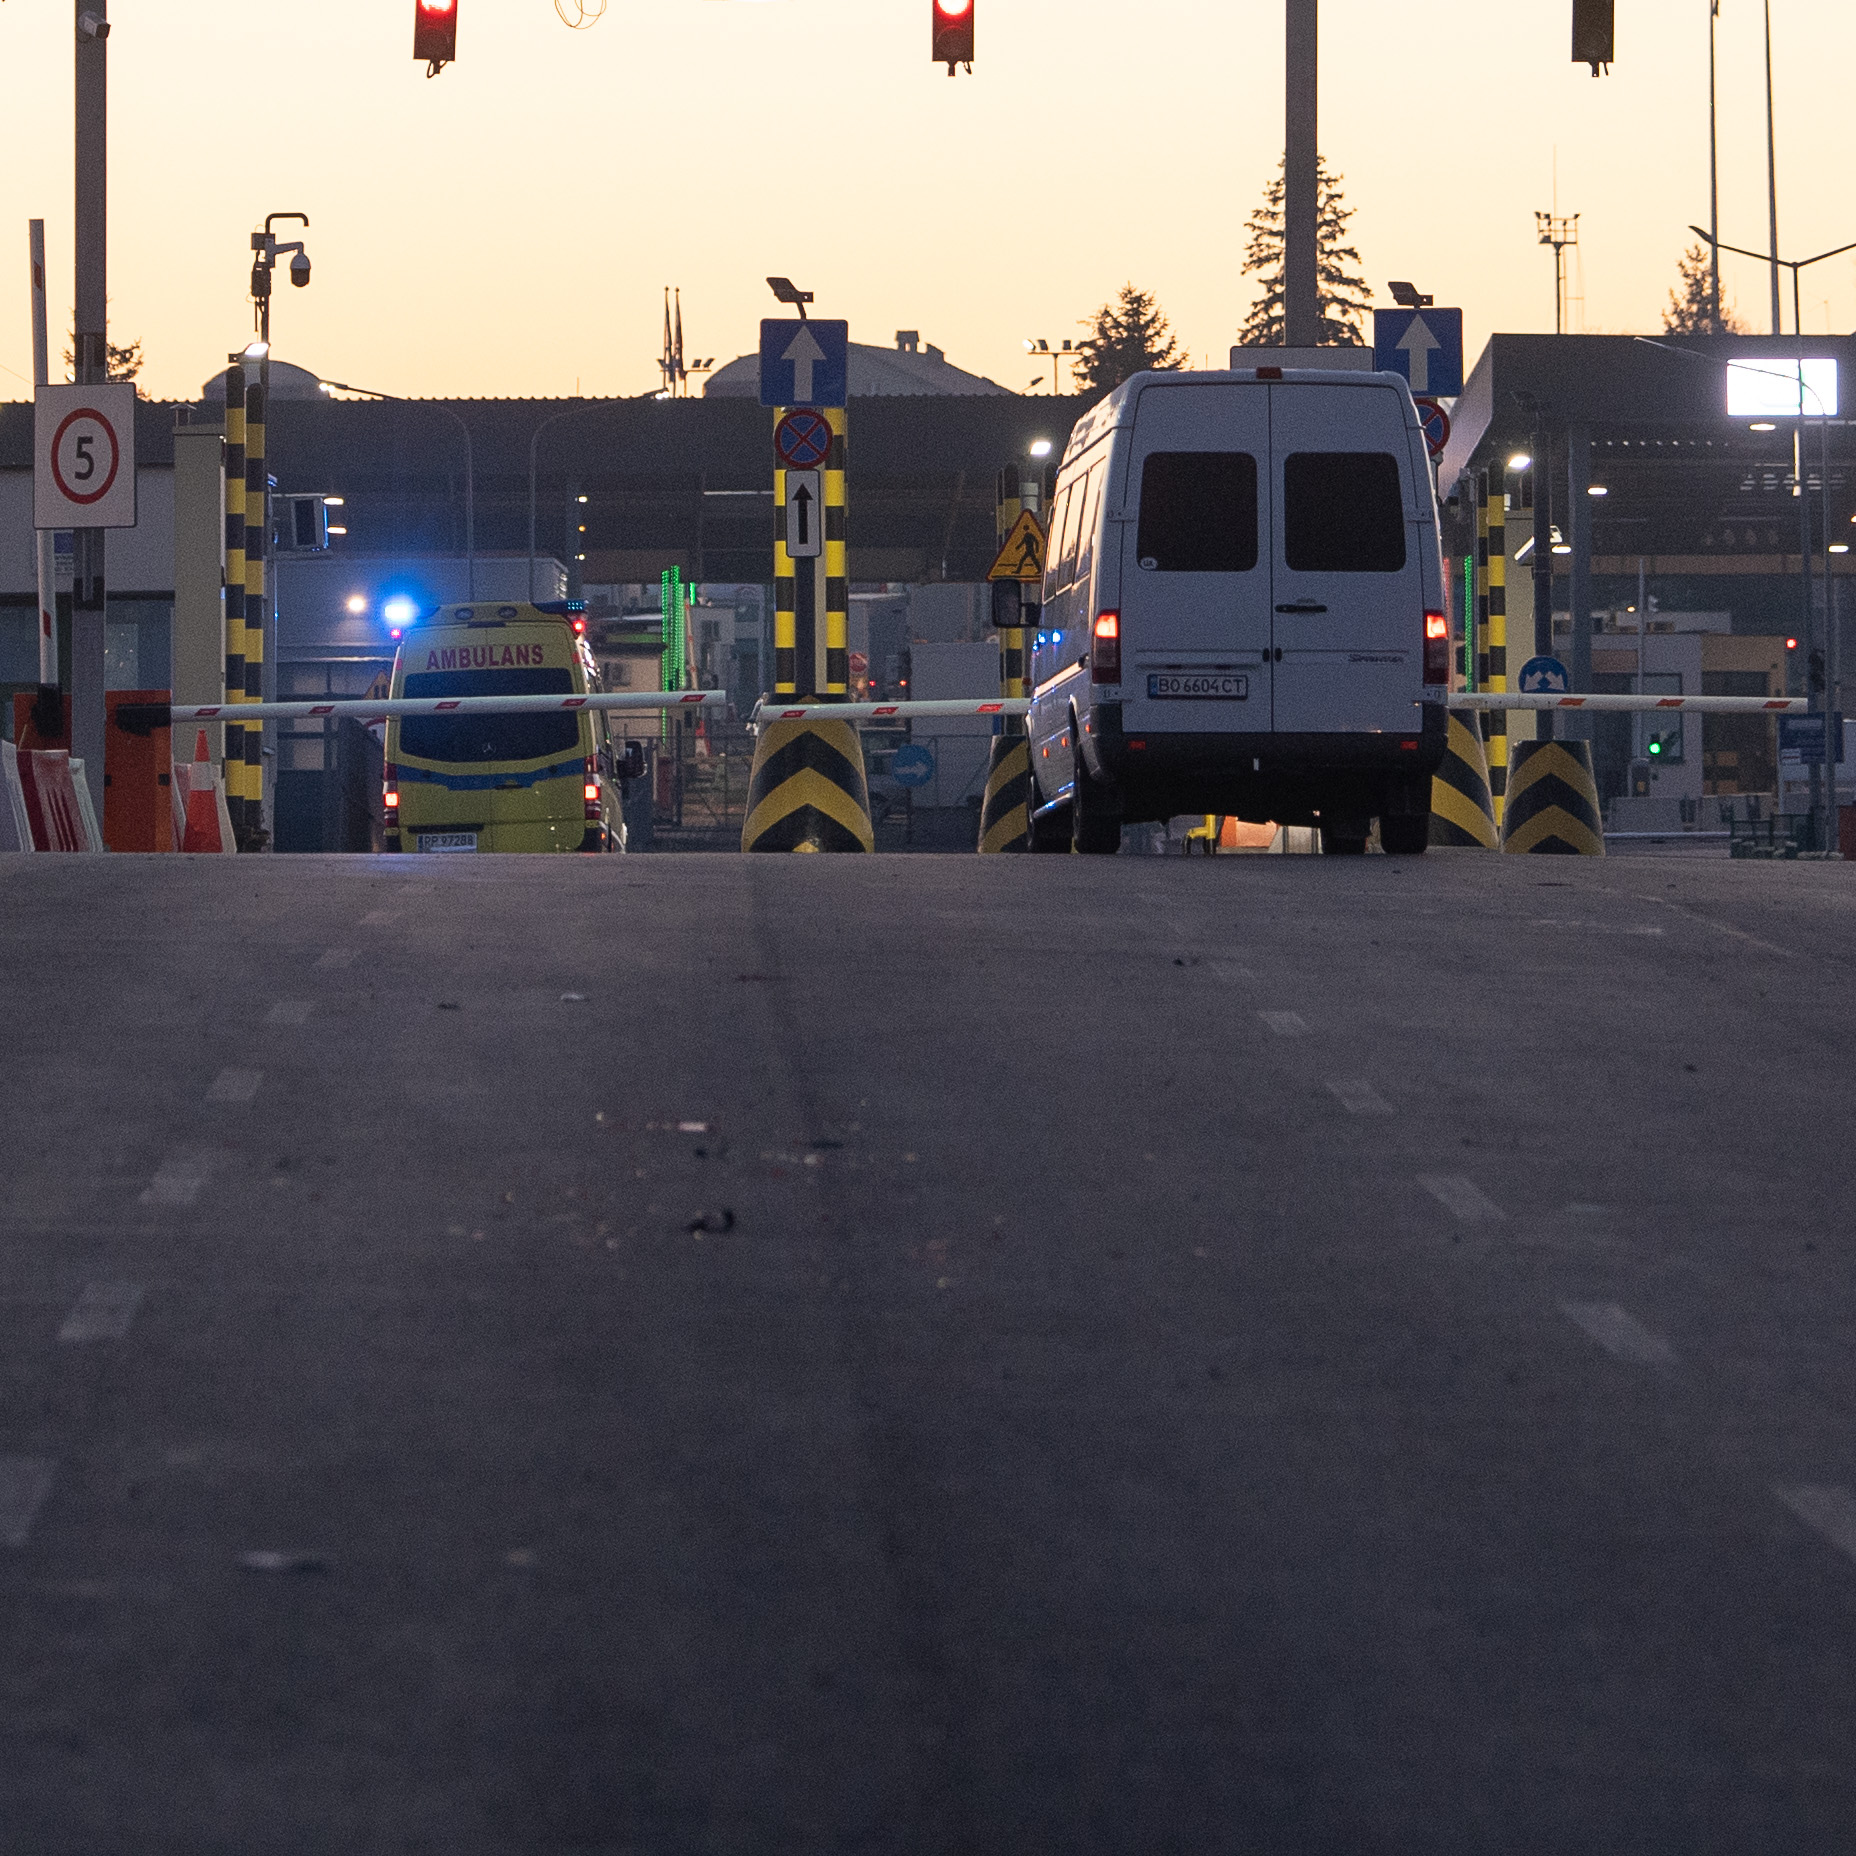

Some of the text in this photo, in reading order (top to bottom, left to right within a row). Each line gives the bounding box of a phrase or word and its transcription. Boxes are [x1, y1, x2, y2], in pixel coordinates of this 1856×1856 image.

[74, 435, 94, 480] 5
[426, 644, 544, 671] AMBULANS
[1159, 678, 1243, 694] BO 6604 CT
[424, 835, 439, 848] RP
